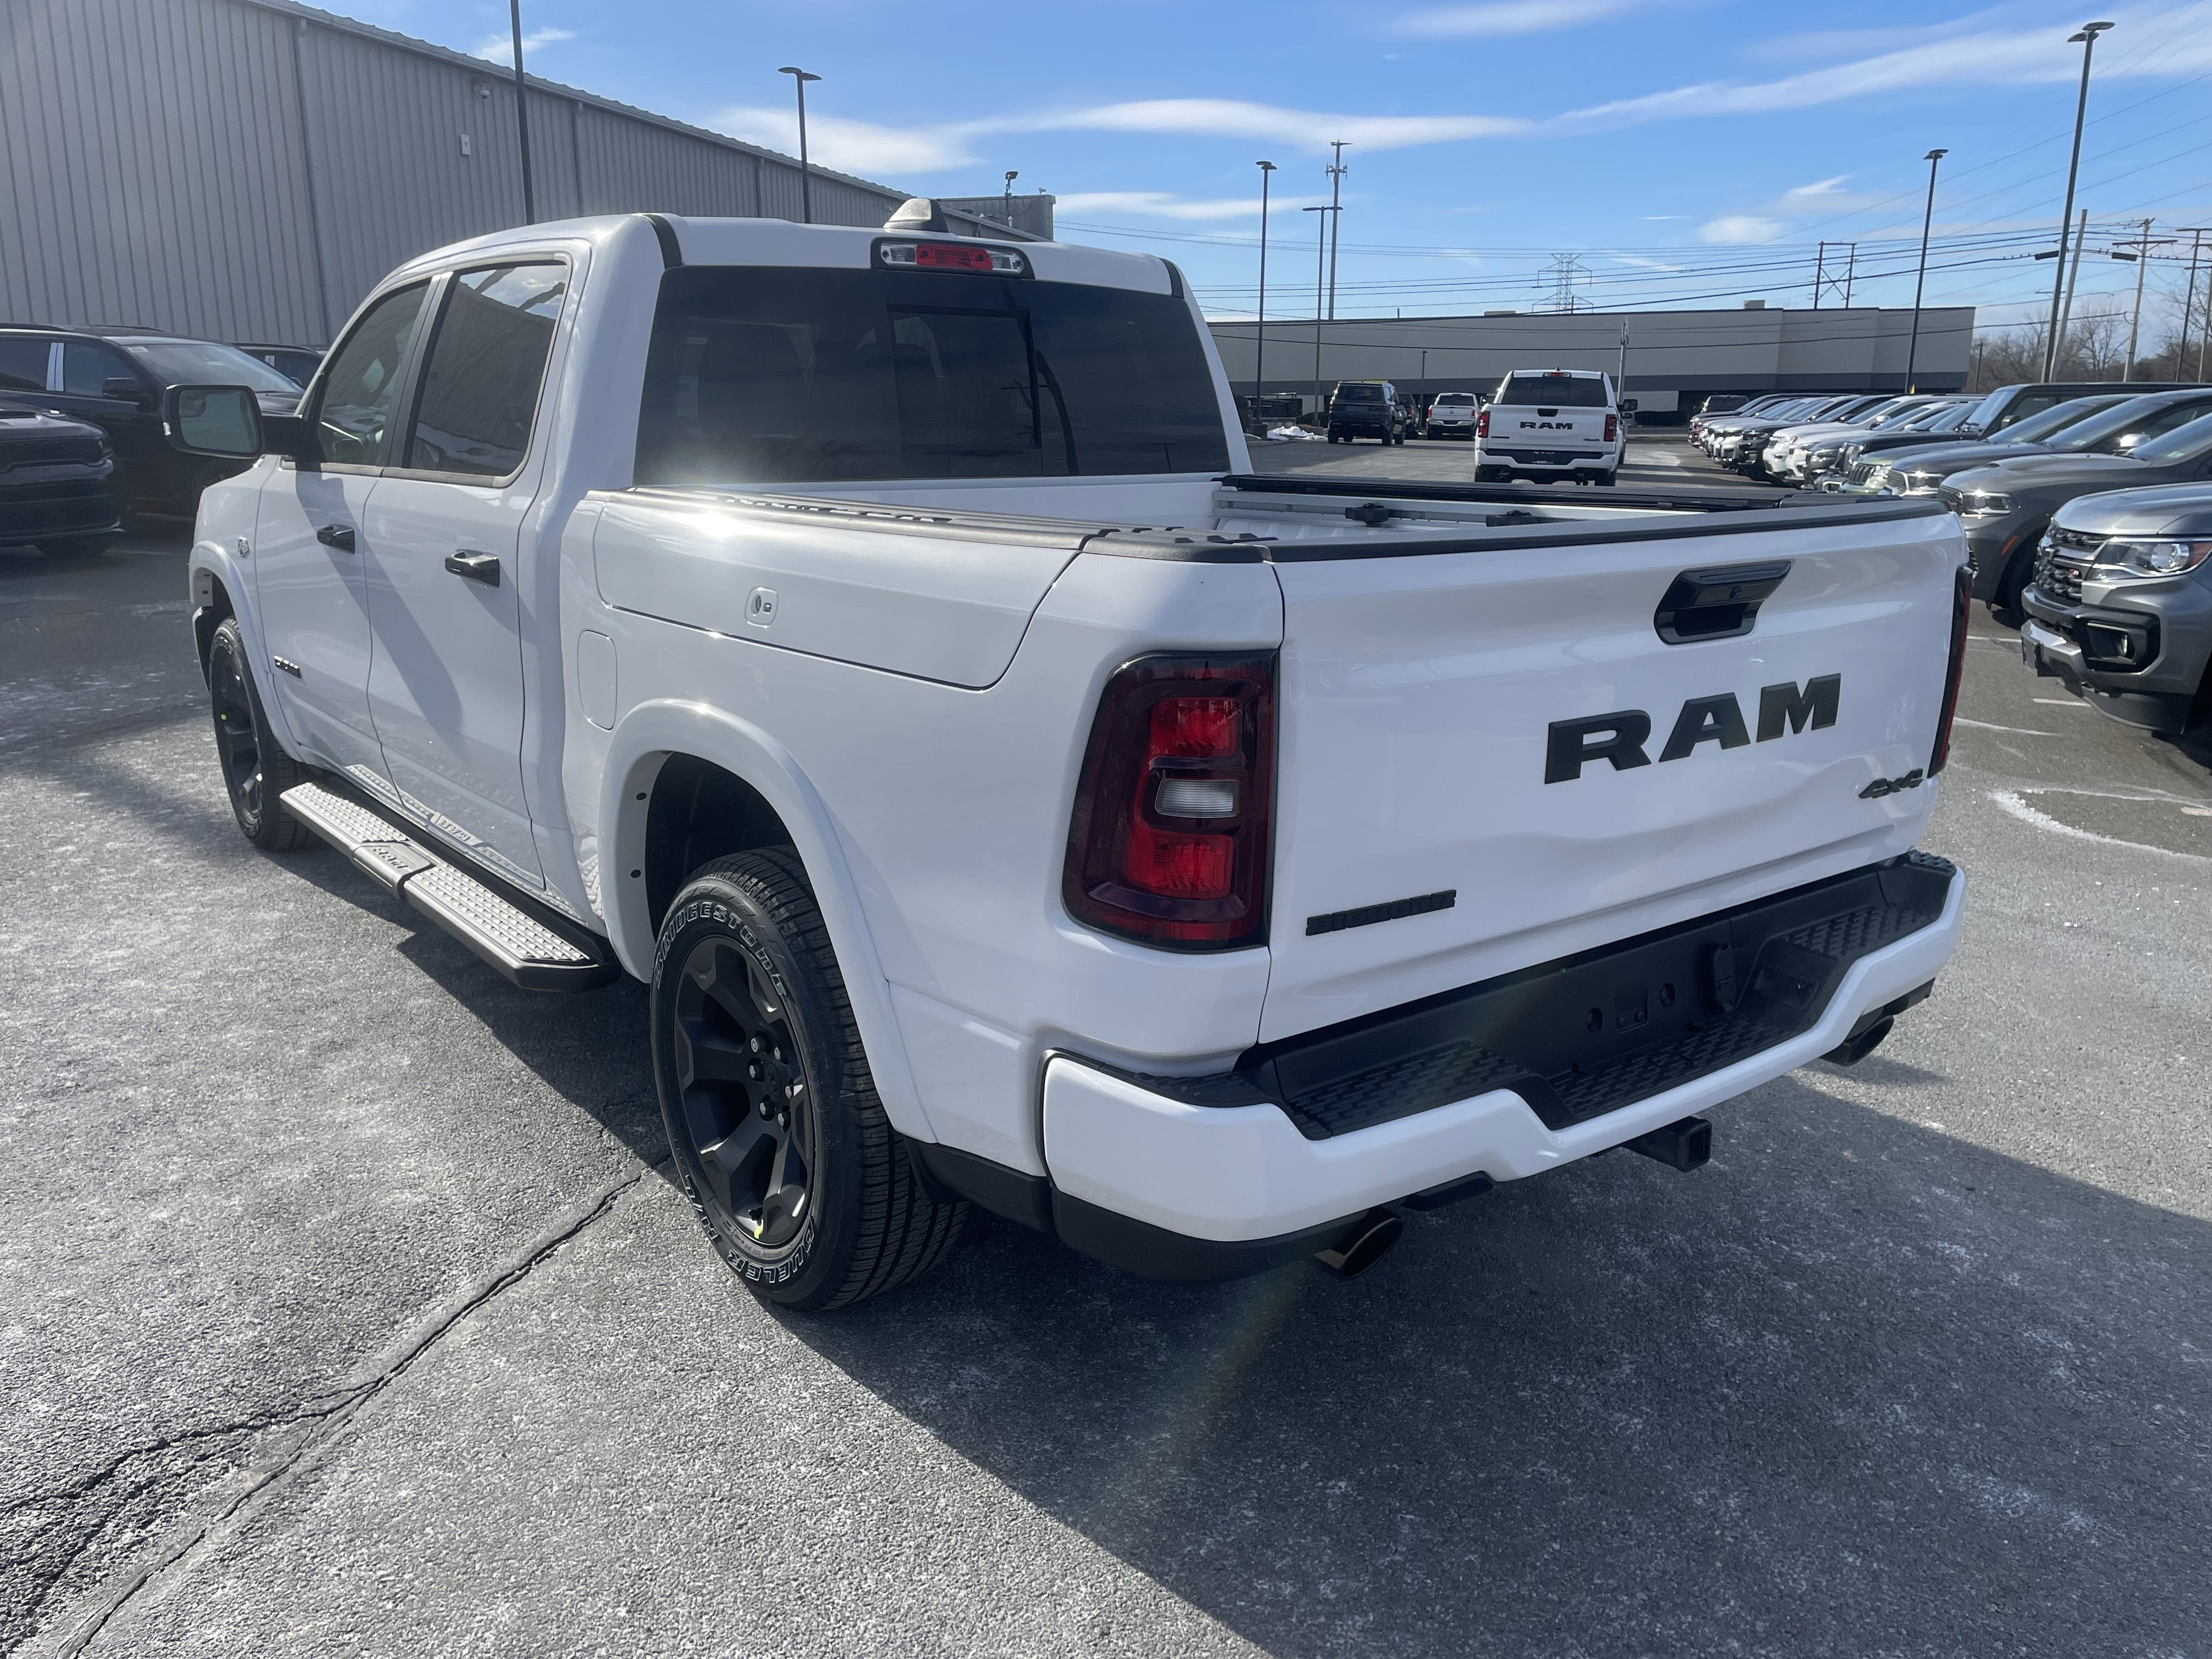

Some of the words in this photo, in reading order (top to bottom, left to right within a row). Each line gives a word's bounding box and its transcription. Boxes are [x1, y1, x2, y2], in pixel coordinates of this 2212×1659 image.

[1544, 673, 1841, 785] RAM
[654, 901, 787, 995] BRIDGESTONE
[727, 1216, 815, 1284] DUELER
